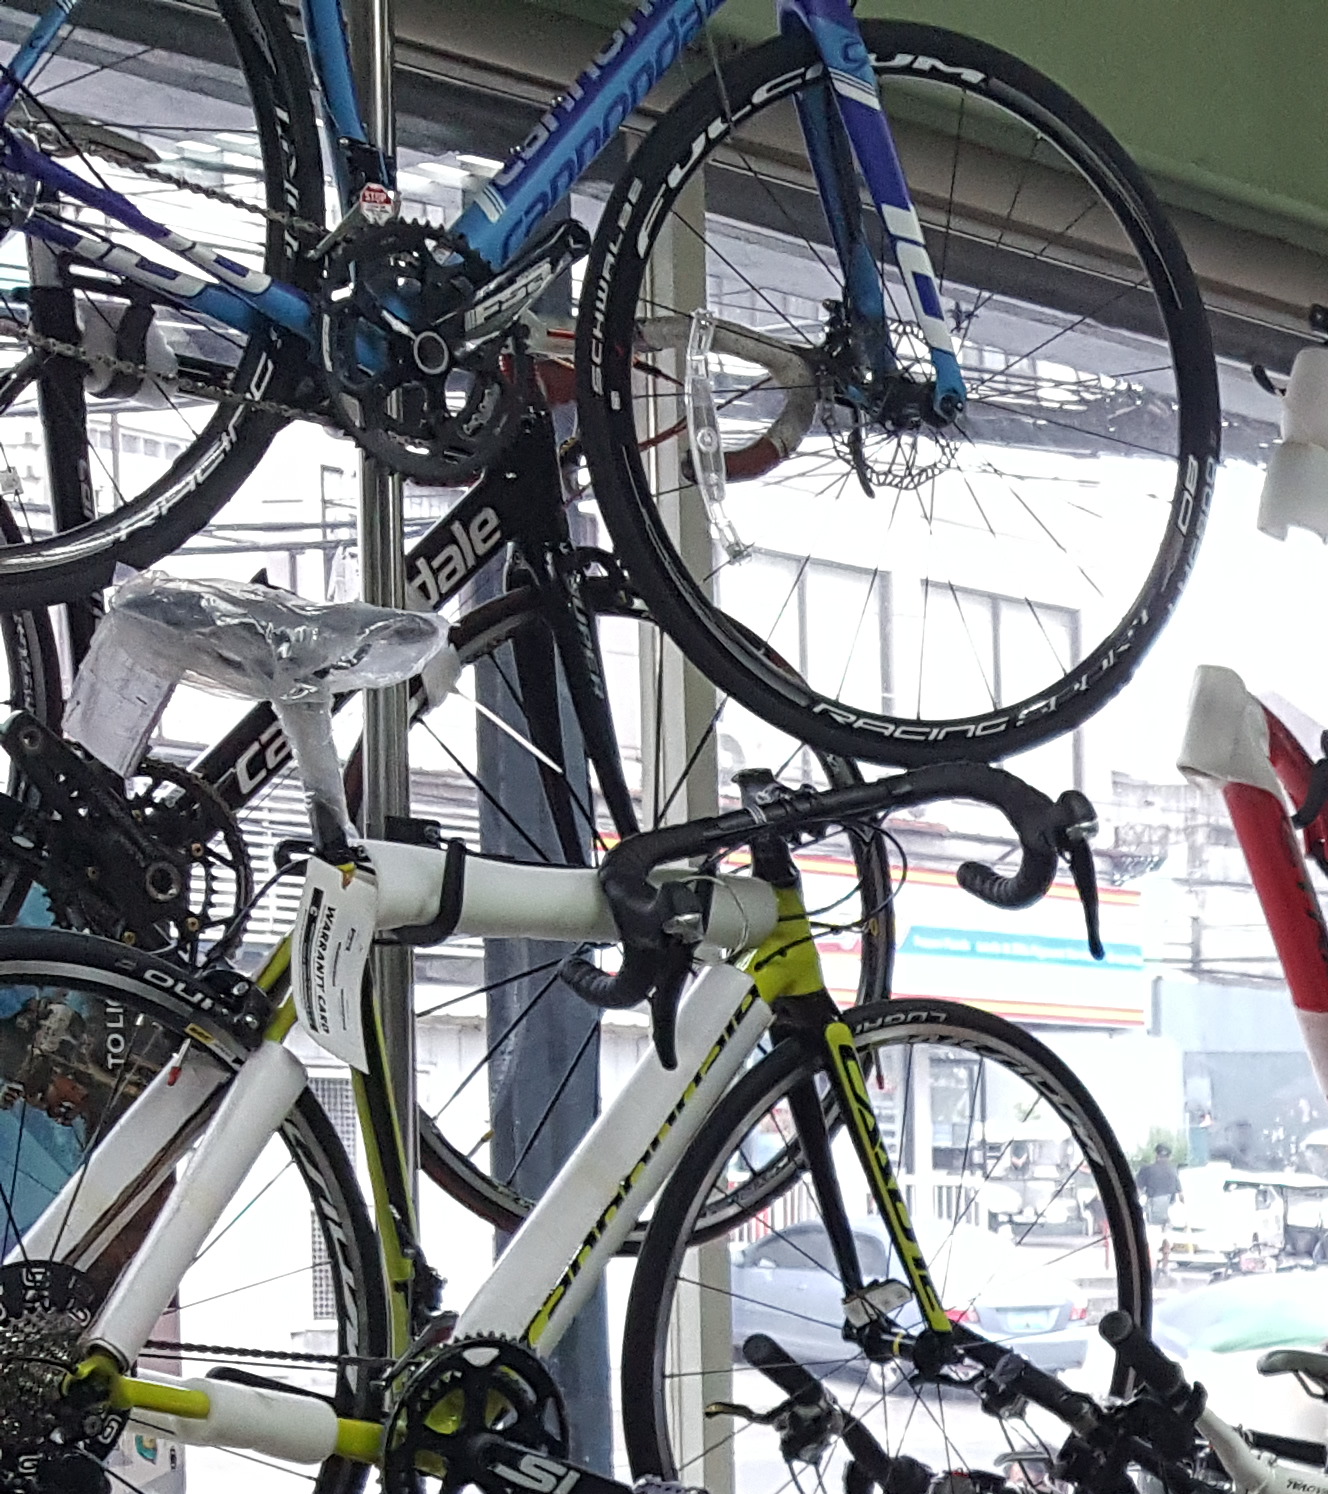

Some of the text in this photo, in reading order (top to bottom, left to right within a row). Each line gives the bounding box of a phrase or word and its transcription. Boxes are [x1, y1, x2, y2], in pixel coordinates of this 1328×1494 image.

[591, 177, 643, 397] SCHWALBE
[811, 702, 1010, 741] RACING
[314, 905, 336, 986] WARRANTY
